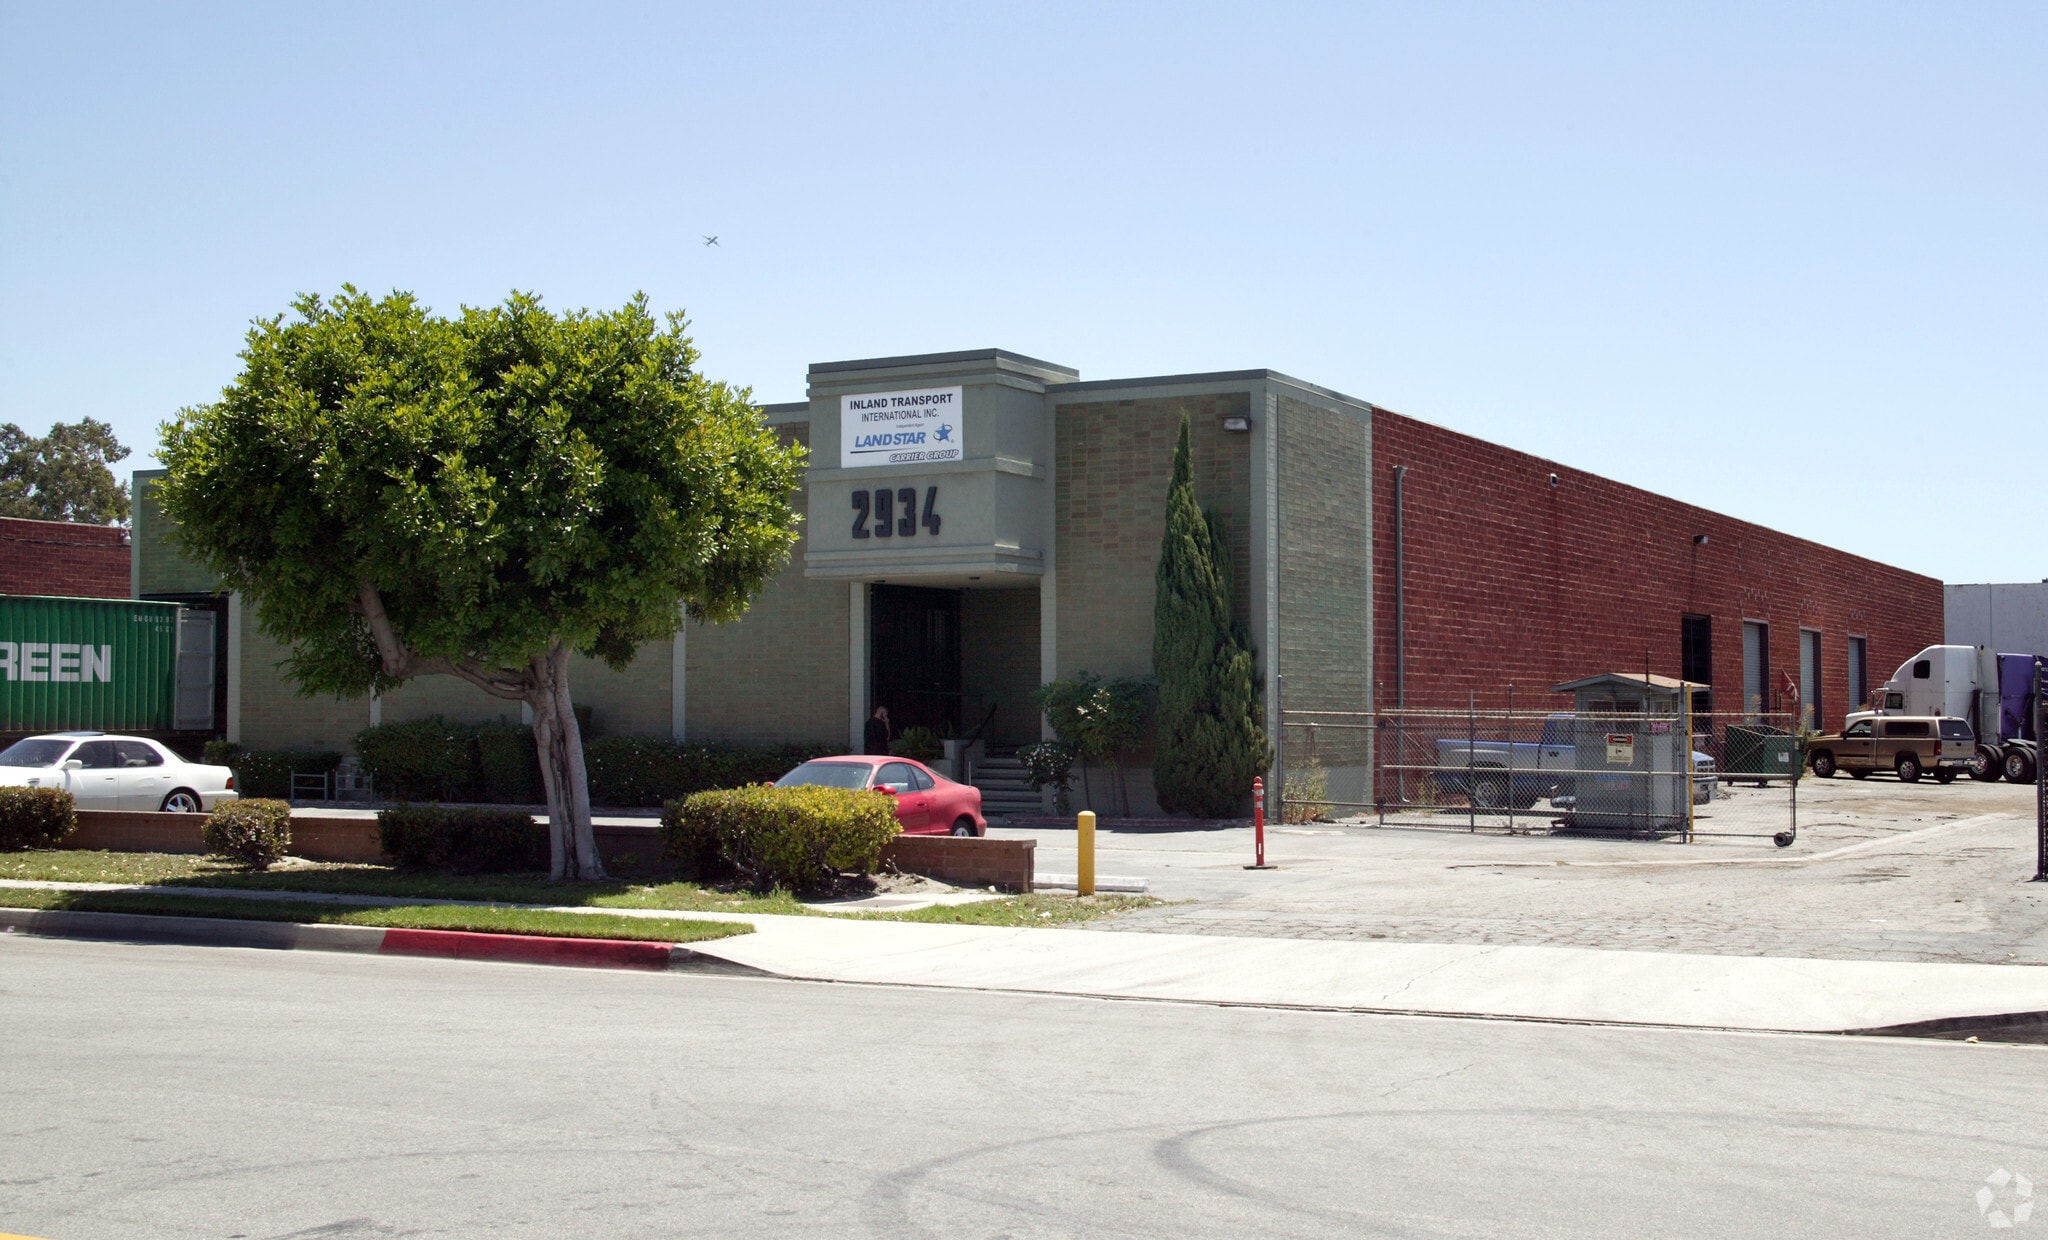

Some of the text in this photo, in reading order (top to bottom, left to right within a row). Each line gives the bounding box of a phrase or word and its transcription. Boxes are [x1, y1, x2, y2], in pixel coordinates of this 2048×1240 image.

[850, 394, 953, 410] INLAND TRANSPORT
[861, 408, 940, 422] INTERNATIONAL INC.
[855, 432, 926, 447] LANDSTAR
[889, 449, 959, 463] CARRIER GROUP
[852, 486, 941, 539] 2934
